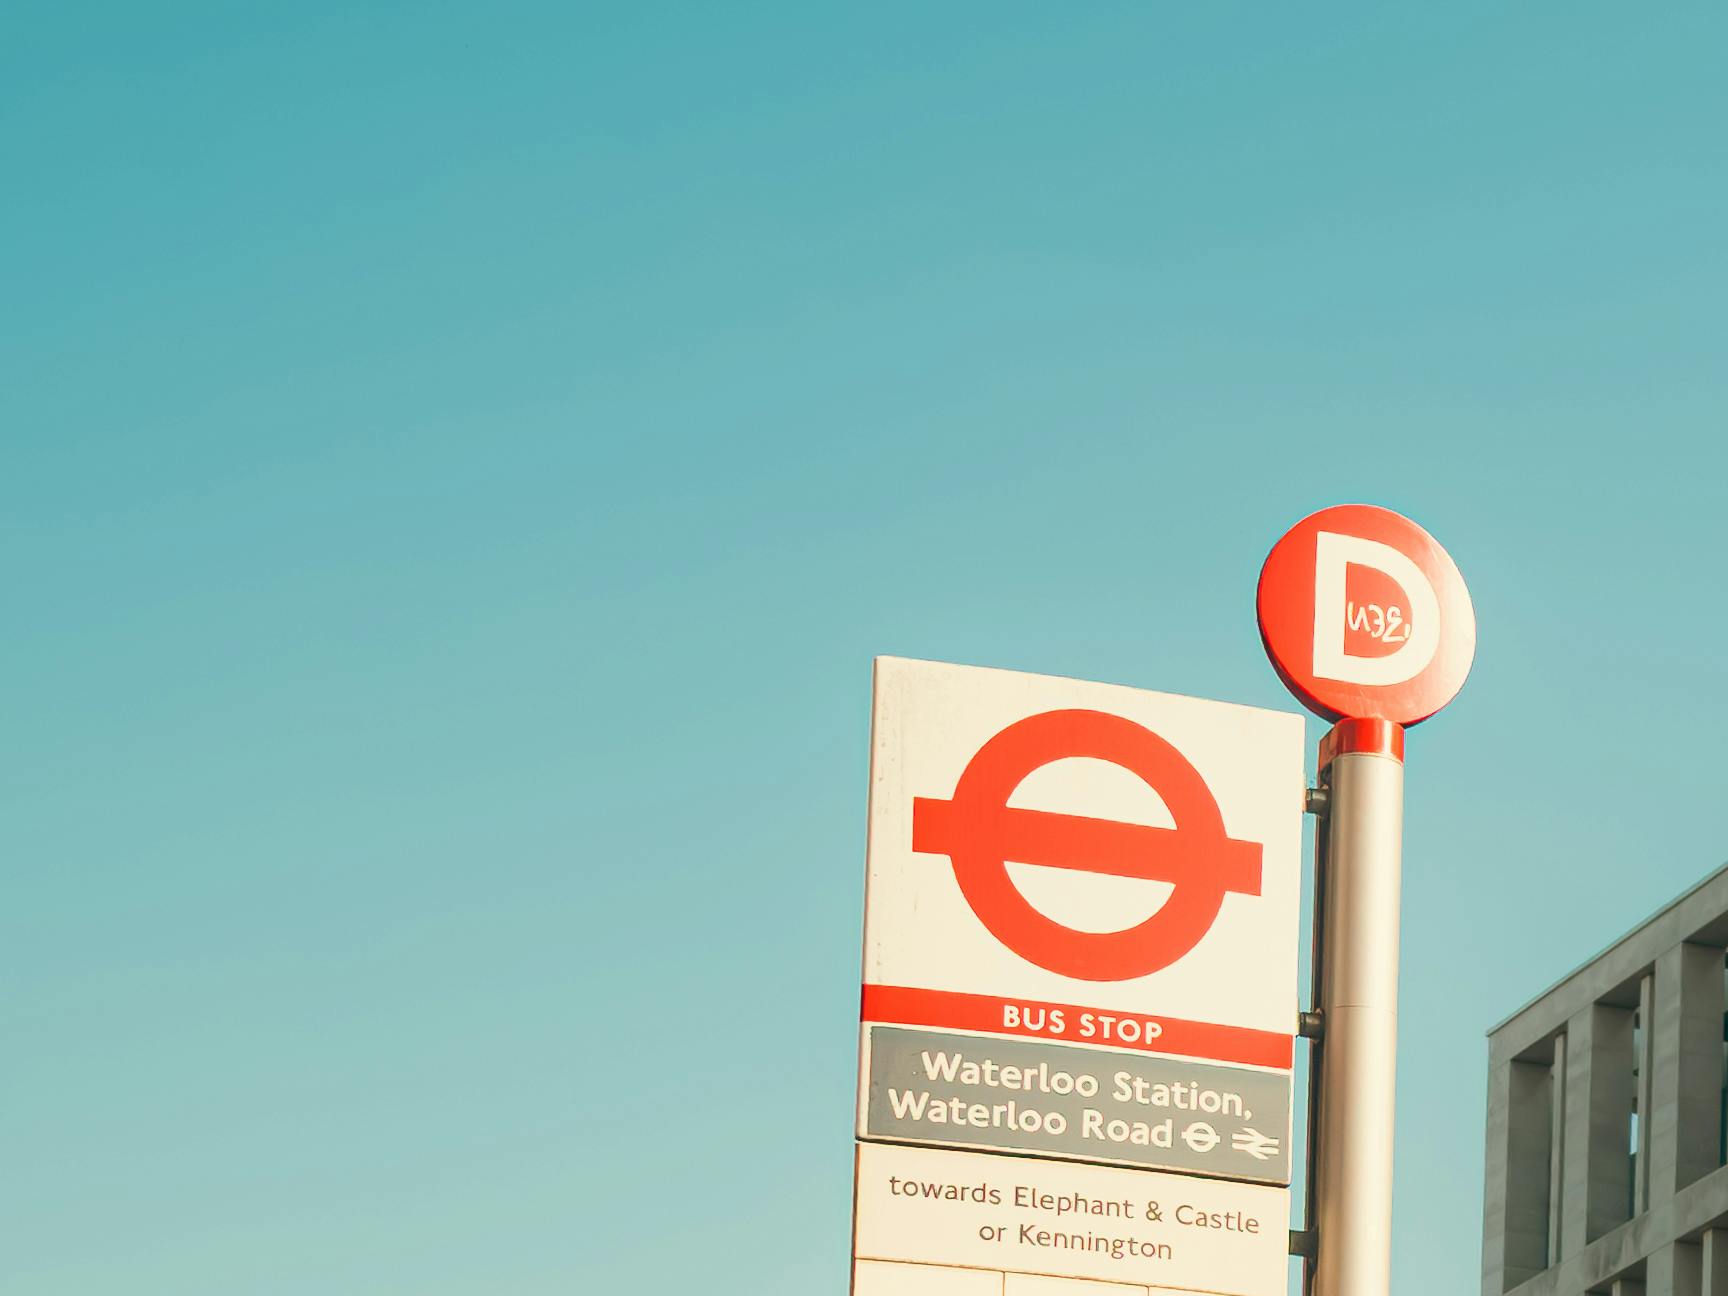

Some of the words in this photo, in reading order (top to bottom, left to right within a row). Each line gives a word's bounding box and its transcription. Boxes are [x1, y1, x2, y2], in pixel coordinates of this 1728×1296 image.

[1313, 531, 1440, 686] D
[1003, 1005, 1065, 1034] BUS
[1079, 1013, 1163, 1045] STOP
[921, 1051, 1099, 1098] Waterloo
[1113, 1071, 1252, 1120] Station,
[888, 1089, 1067, 1135] Waterloo
[1082, 1108, 1173, 1148] Road
[889, 1175, 1001, 1206] towards
[1014, 1186, 1134, 1220] Elephant
[1145, 1201, 1163, 1222] &
[1175, 1205, 1260, 1234] Castle
[979, 1224, 1007, 1241] or
[1019, 1224, 1173, 1260] Kennington
